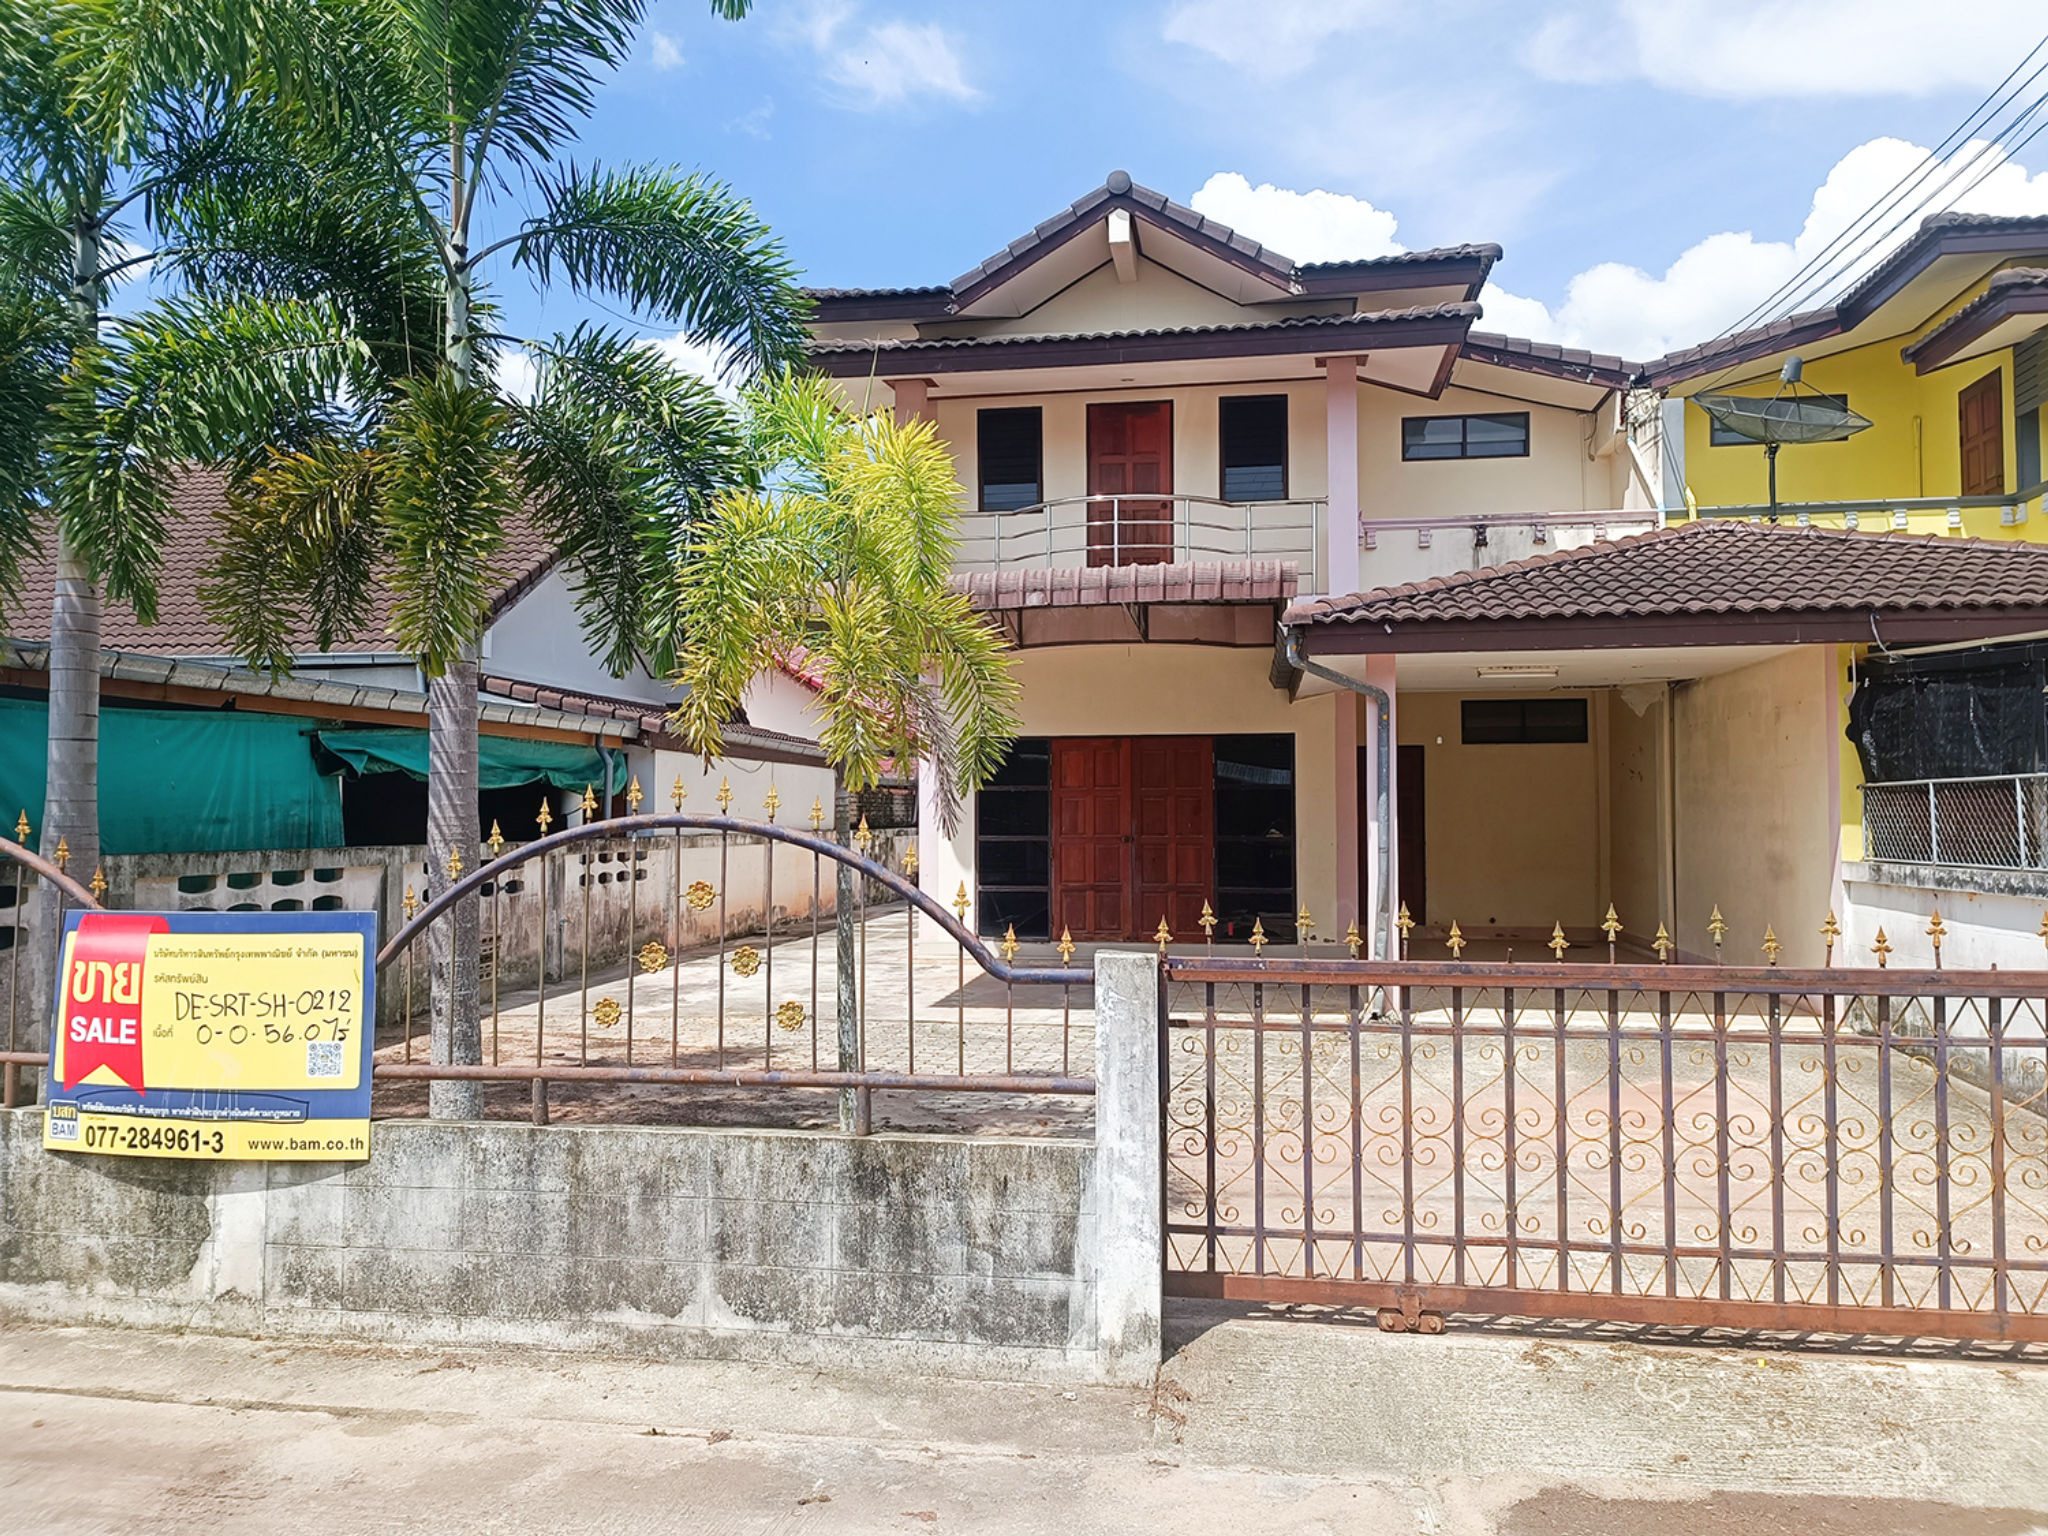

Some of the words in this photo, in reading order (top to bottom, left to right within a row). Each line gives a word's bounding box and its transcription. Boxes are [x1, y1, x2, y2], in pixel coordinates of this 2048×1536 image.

[72, 960, 140, 1005] ขาย
[153, 972, 209, 984] รหัสทรัพย์สิน
[174, 989, 351, 1021] DE-SRT-SH-0212
[70, 1016, 137, 1044] SALE
[52, 1106, 77, 1119] บสก
[52, 1122, 75, 1137] BAM
[85, 1124, 224, 1153] 077-284961-3
[248, 1137, 364, 1151] www.bam.co.th
